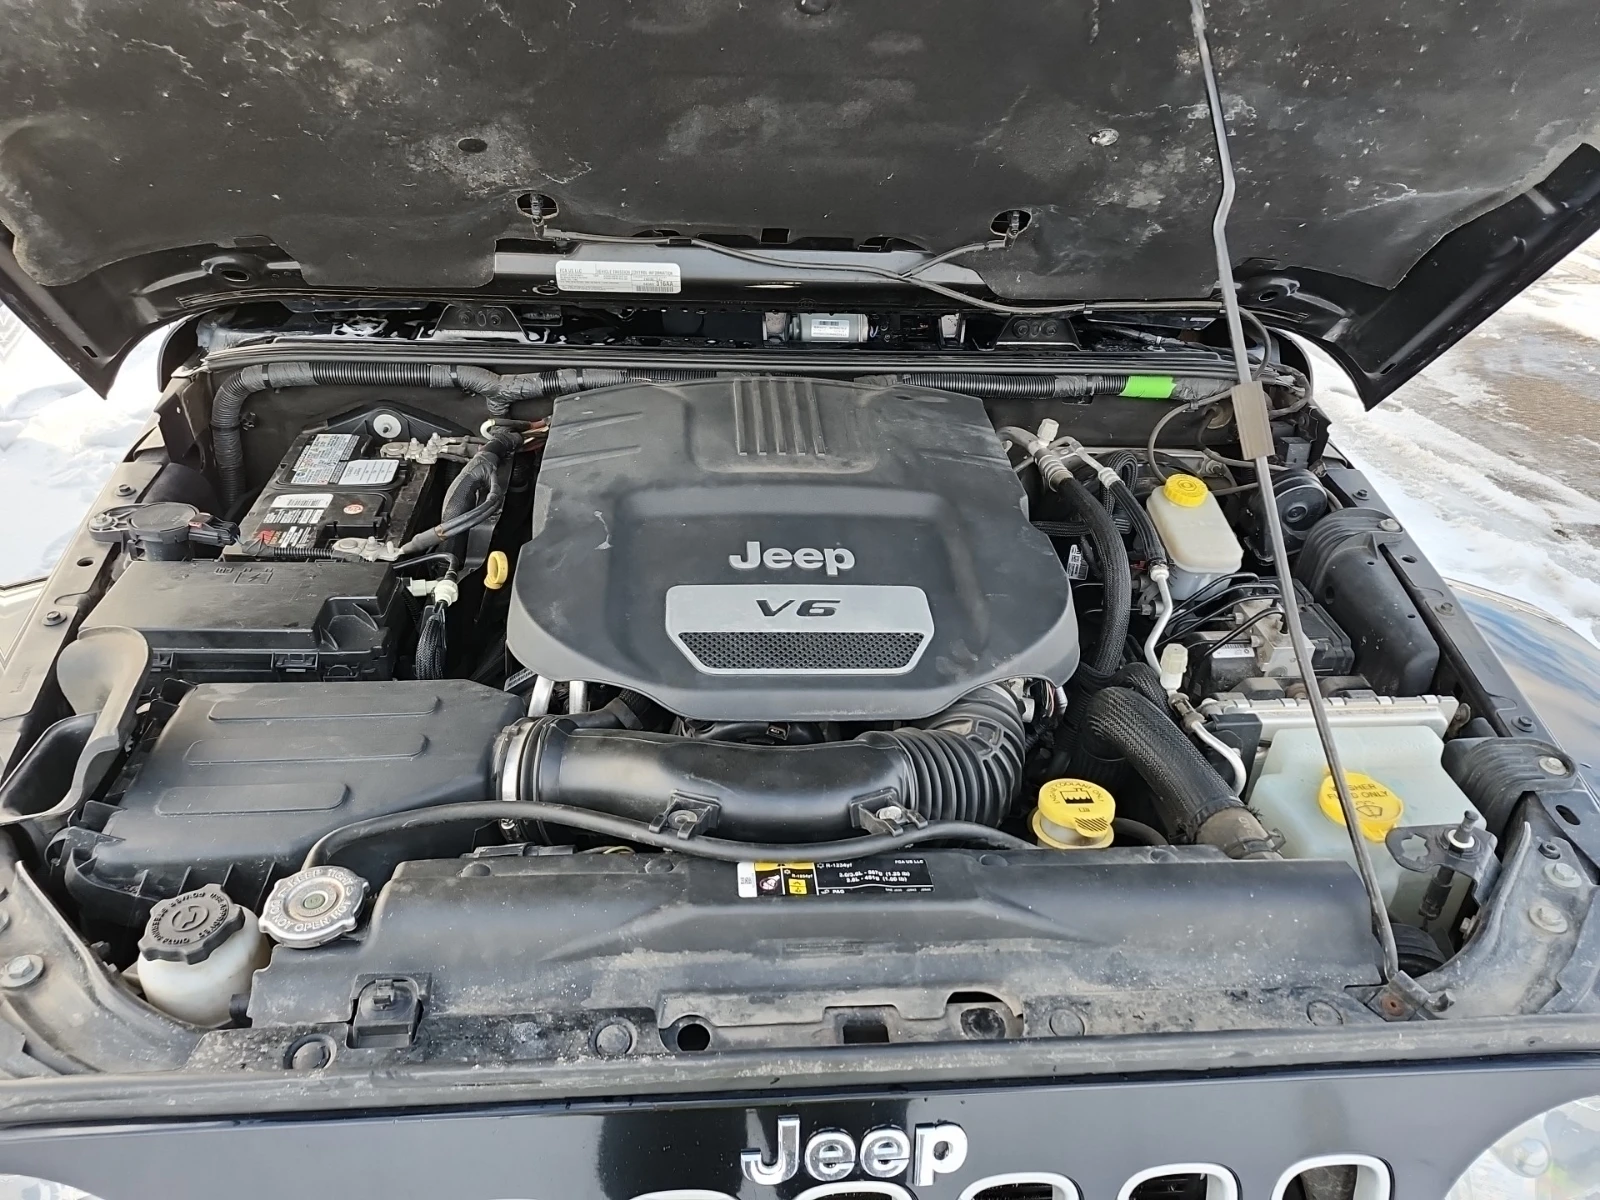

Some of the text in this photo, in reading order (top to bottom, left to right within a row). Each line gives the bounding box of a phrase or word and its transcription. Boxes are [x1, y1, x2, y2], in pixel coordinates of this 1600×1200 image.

[729, 541, 855, 576] Jeep
[756, 599, 841, 617] V6
[1361, 790, 1389, 798] ONLY
[288, 869, 323, 888] KEEP
[740, 1114, 968, 1187] Jeep
